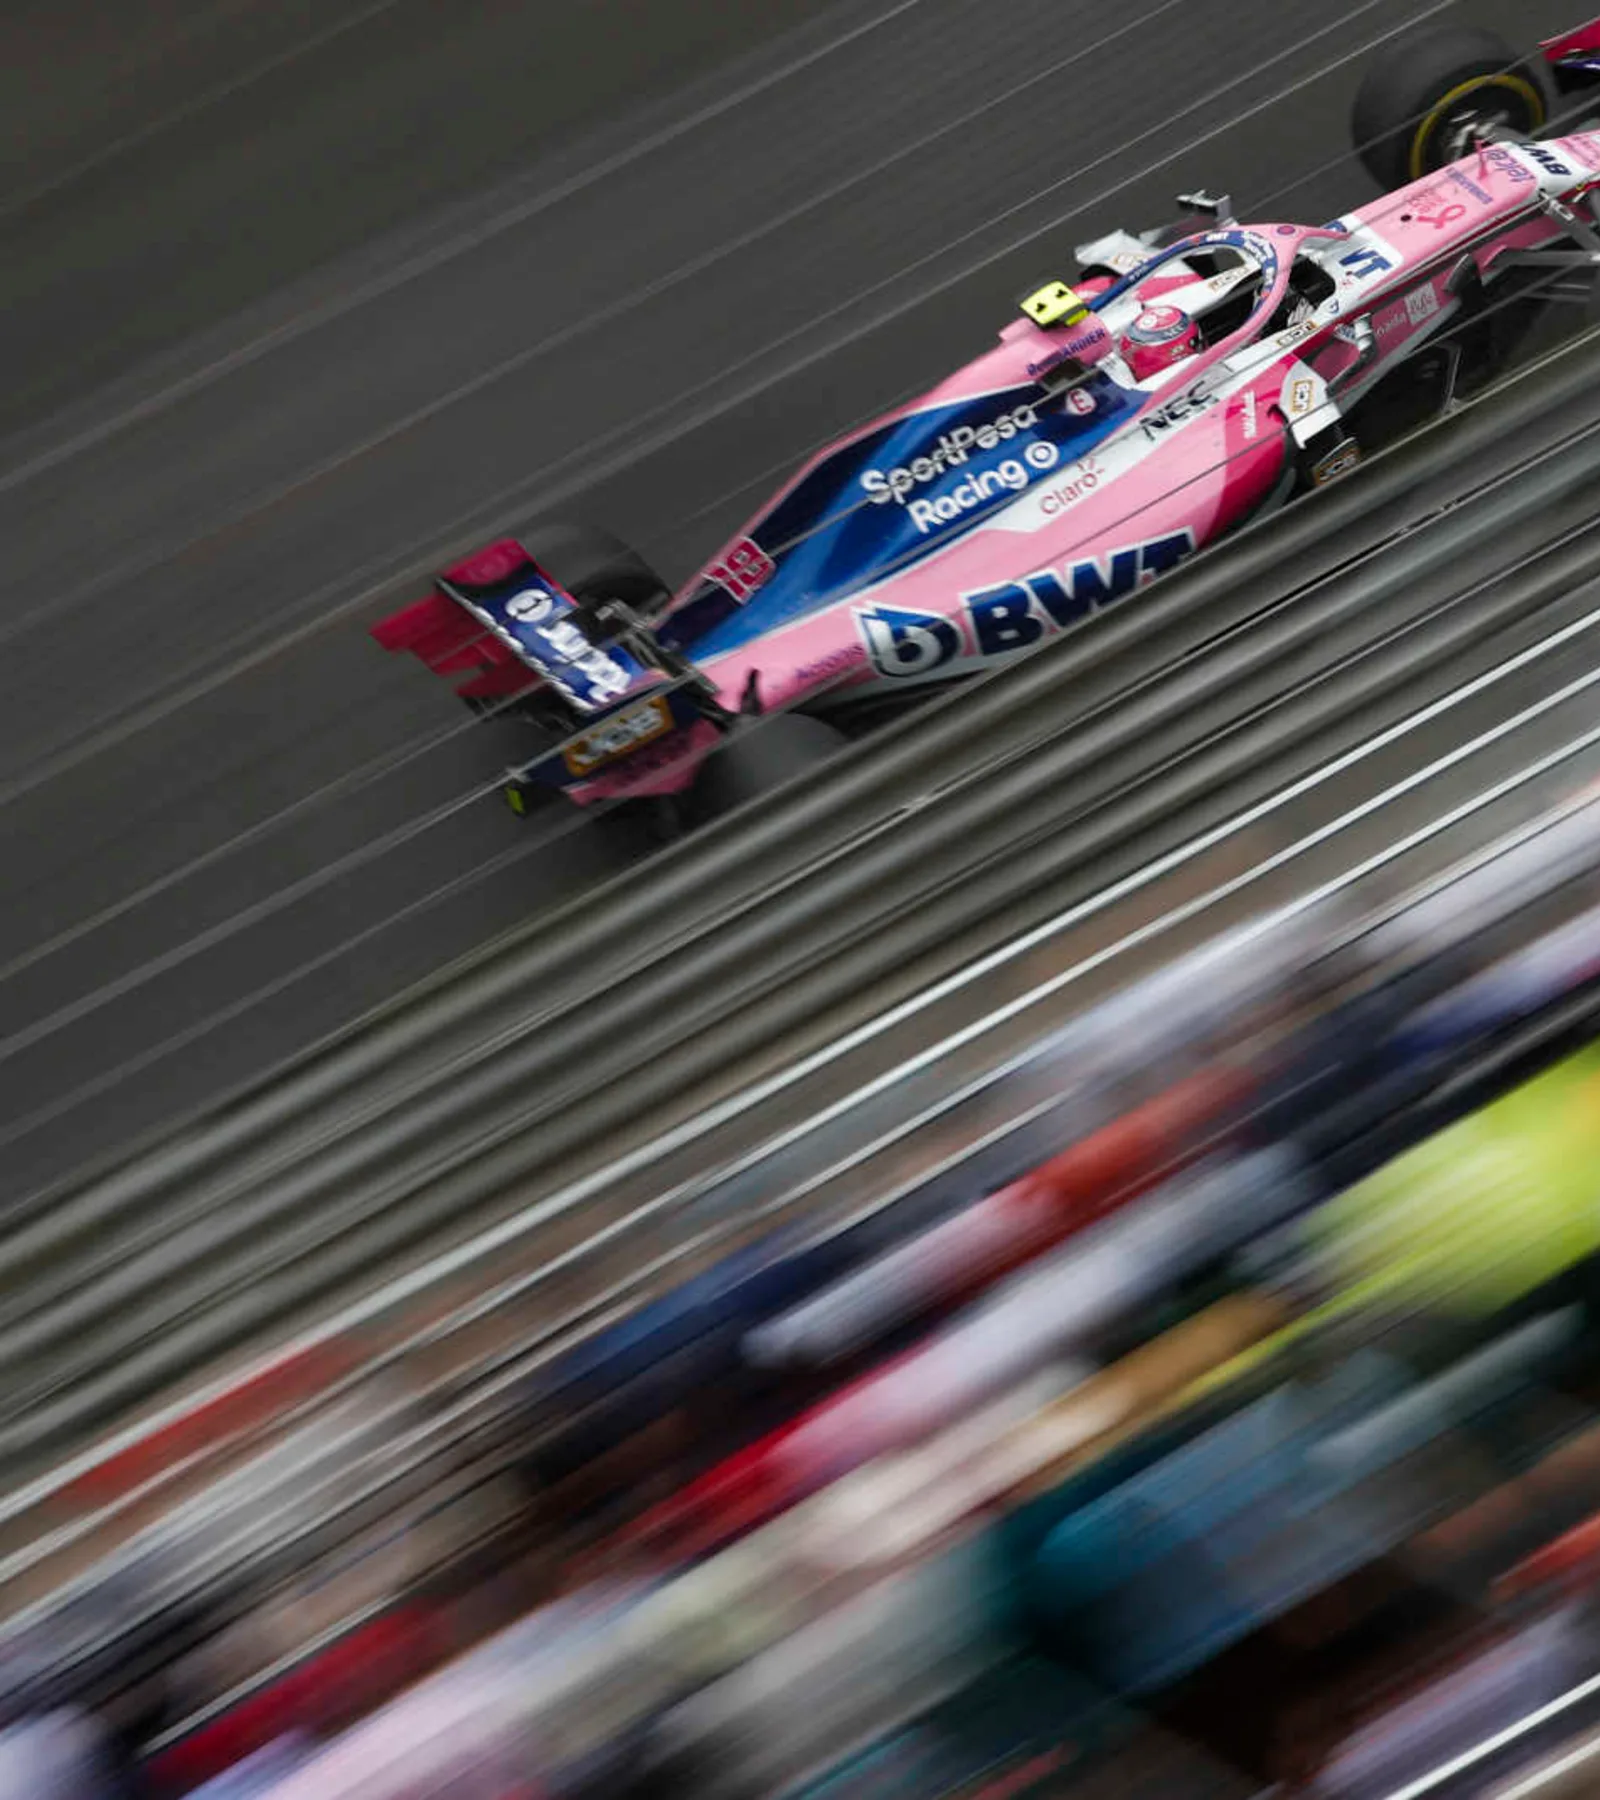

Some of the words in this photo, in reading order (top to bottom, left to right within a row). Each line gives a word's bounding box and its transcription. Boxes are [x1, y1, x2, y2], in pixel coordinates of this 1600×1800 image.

[1139, 383, 1220, 441] NEC
[860, 404, 1038, 505] SportPesa
[906, 459, 1030, 534] Racing
[1039, 468, 1099, 515] Claro
[704, 538, 772, 600] 18
[965, 530, 1195, 656] BWT
